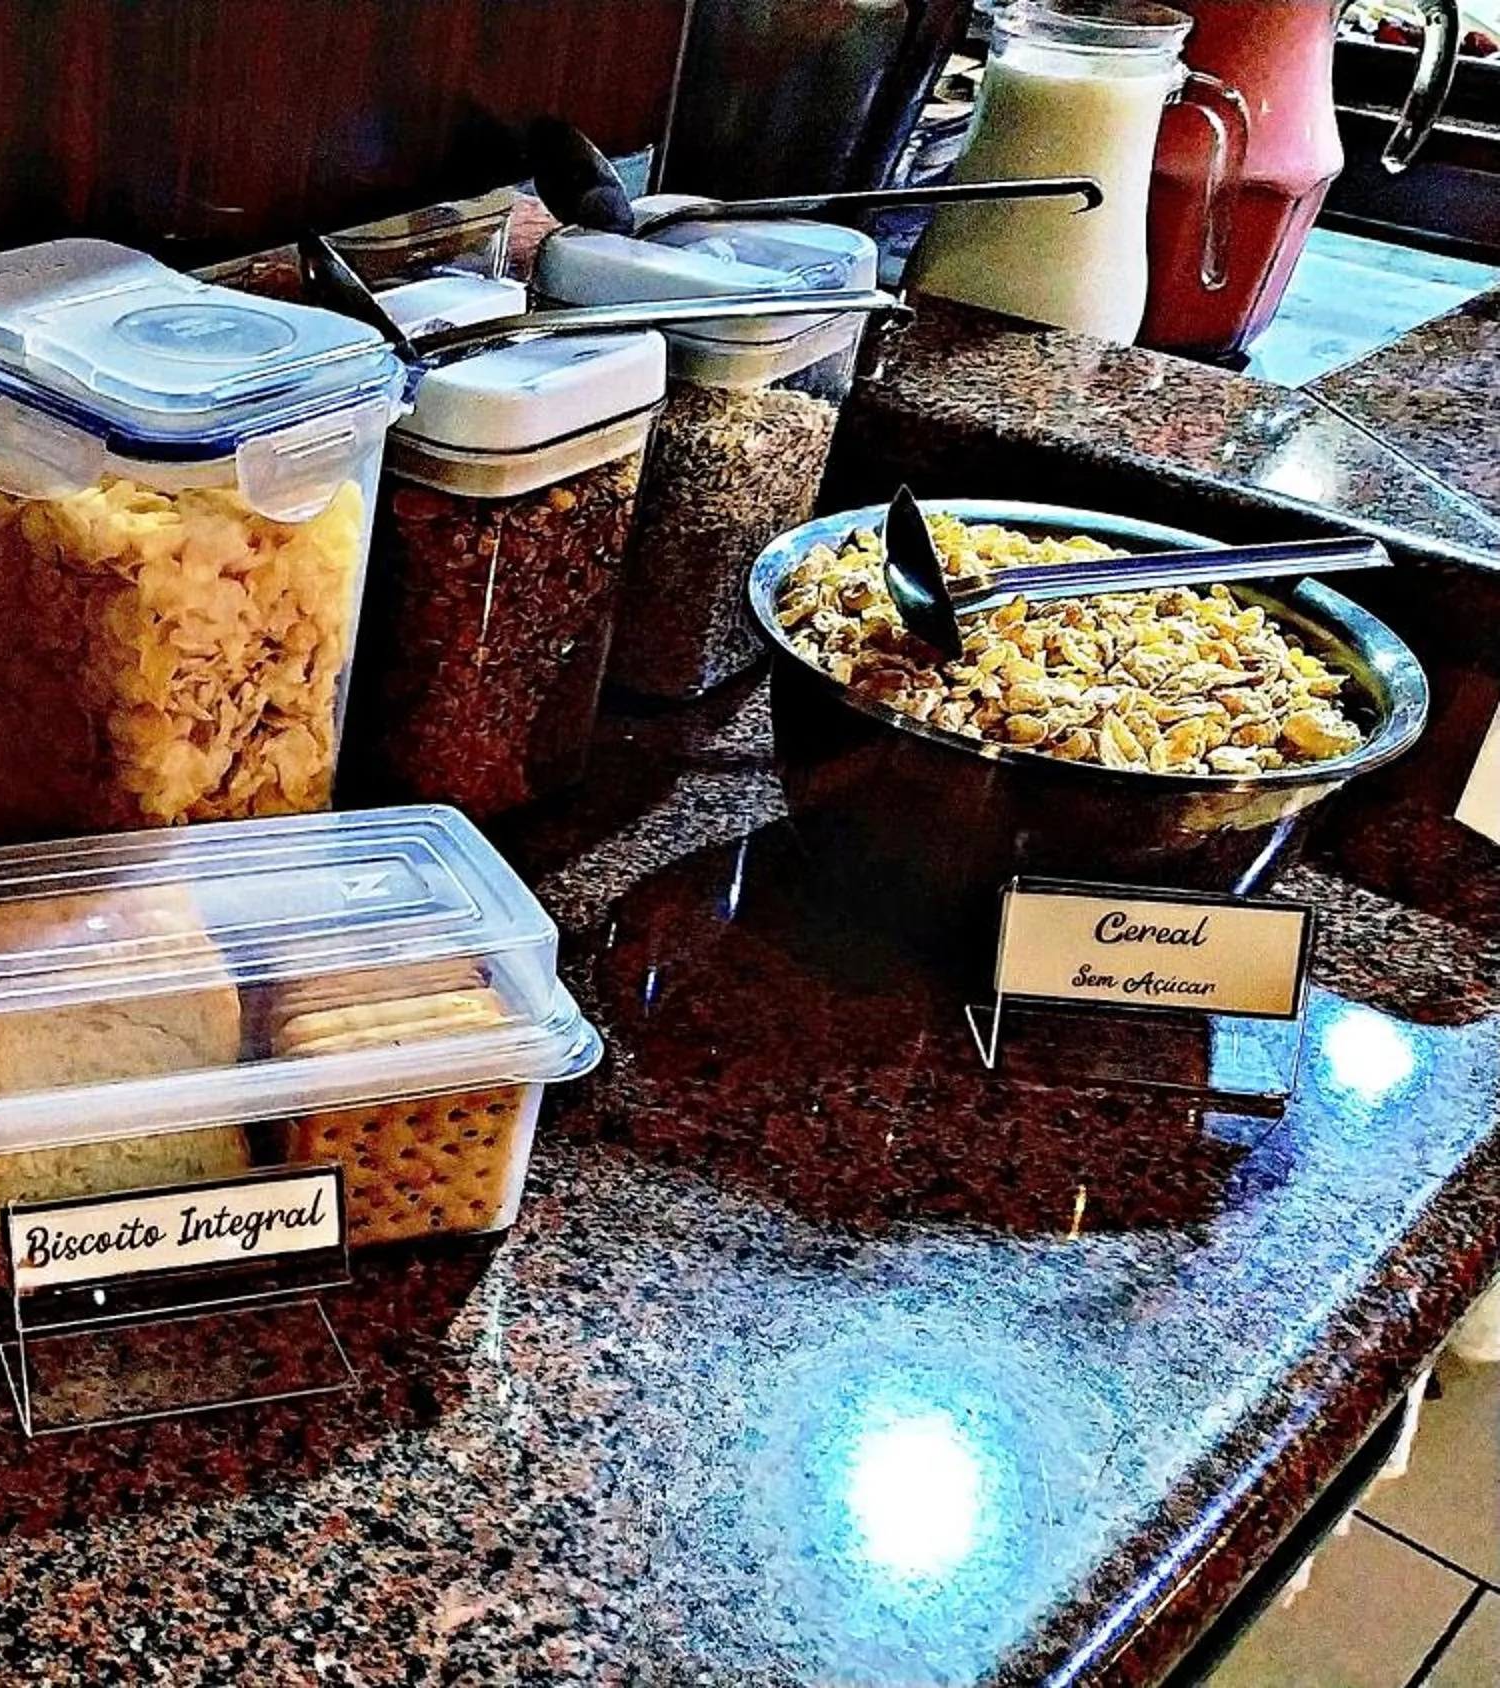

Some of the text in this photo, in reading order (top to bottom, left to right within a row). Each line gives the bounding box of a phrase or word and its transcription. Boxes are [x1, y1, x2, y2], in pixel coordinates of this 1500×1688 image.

[1094, 911, 1210, 947] Cereal
[1071, 963, 1217, 997] Sem Açúcar
[25, 1187, 327, 1268] Biscoito Integral
